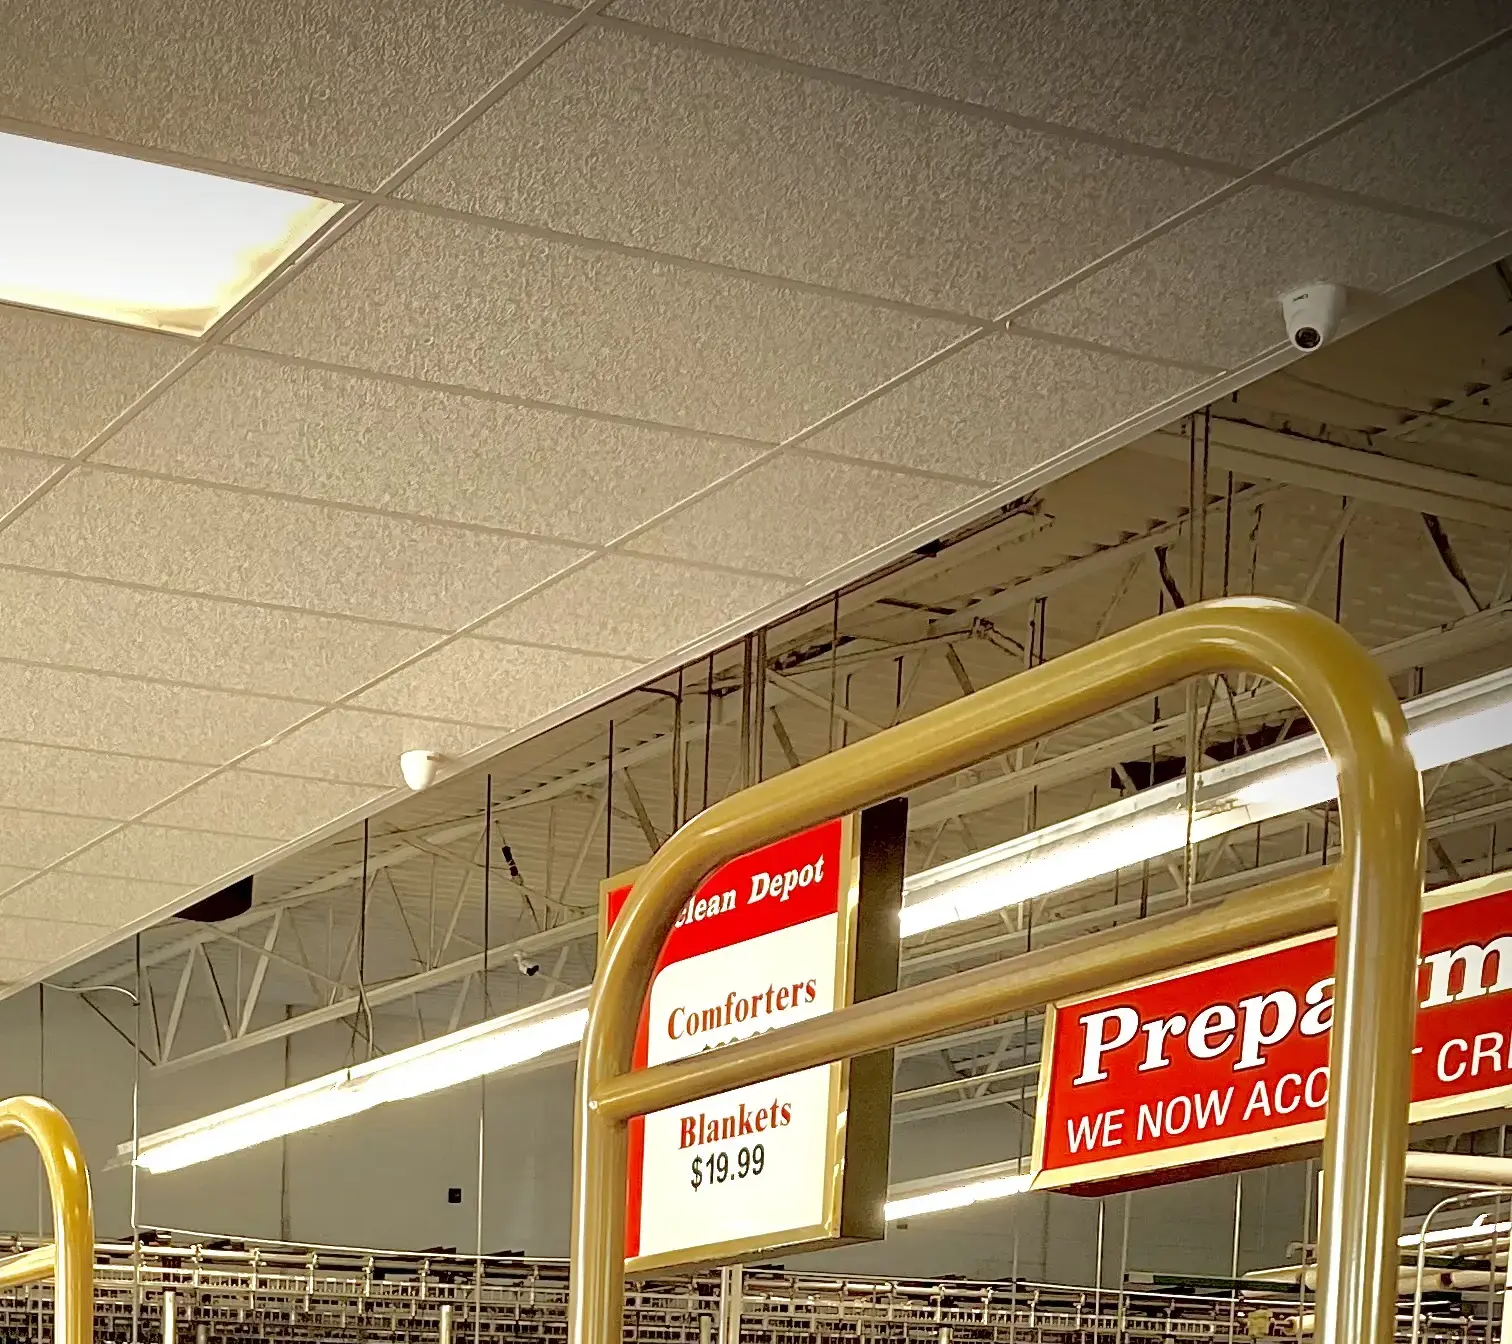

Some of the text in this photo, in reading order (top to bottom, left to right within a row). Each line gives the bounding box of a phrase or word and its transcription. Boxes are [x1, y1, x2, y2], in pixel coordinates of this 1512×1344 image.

[747, 853, 825, 905] Depot
[667, 978, 817, 1040] Comforters
[1073, 936, 1512, 1086] Prepam
[678, 1097, 792, 1150] Blankets
[1067, 1108, 1123, 1154] WE
[1136, 1086, 1234, 1141] NOW
[691, 1143, 764, 1192] $19.99
